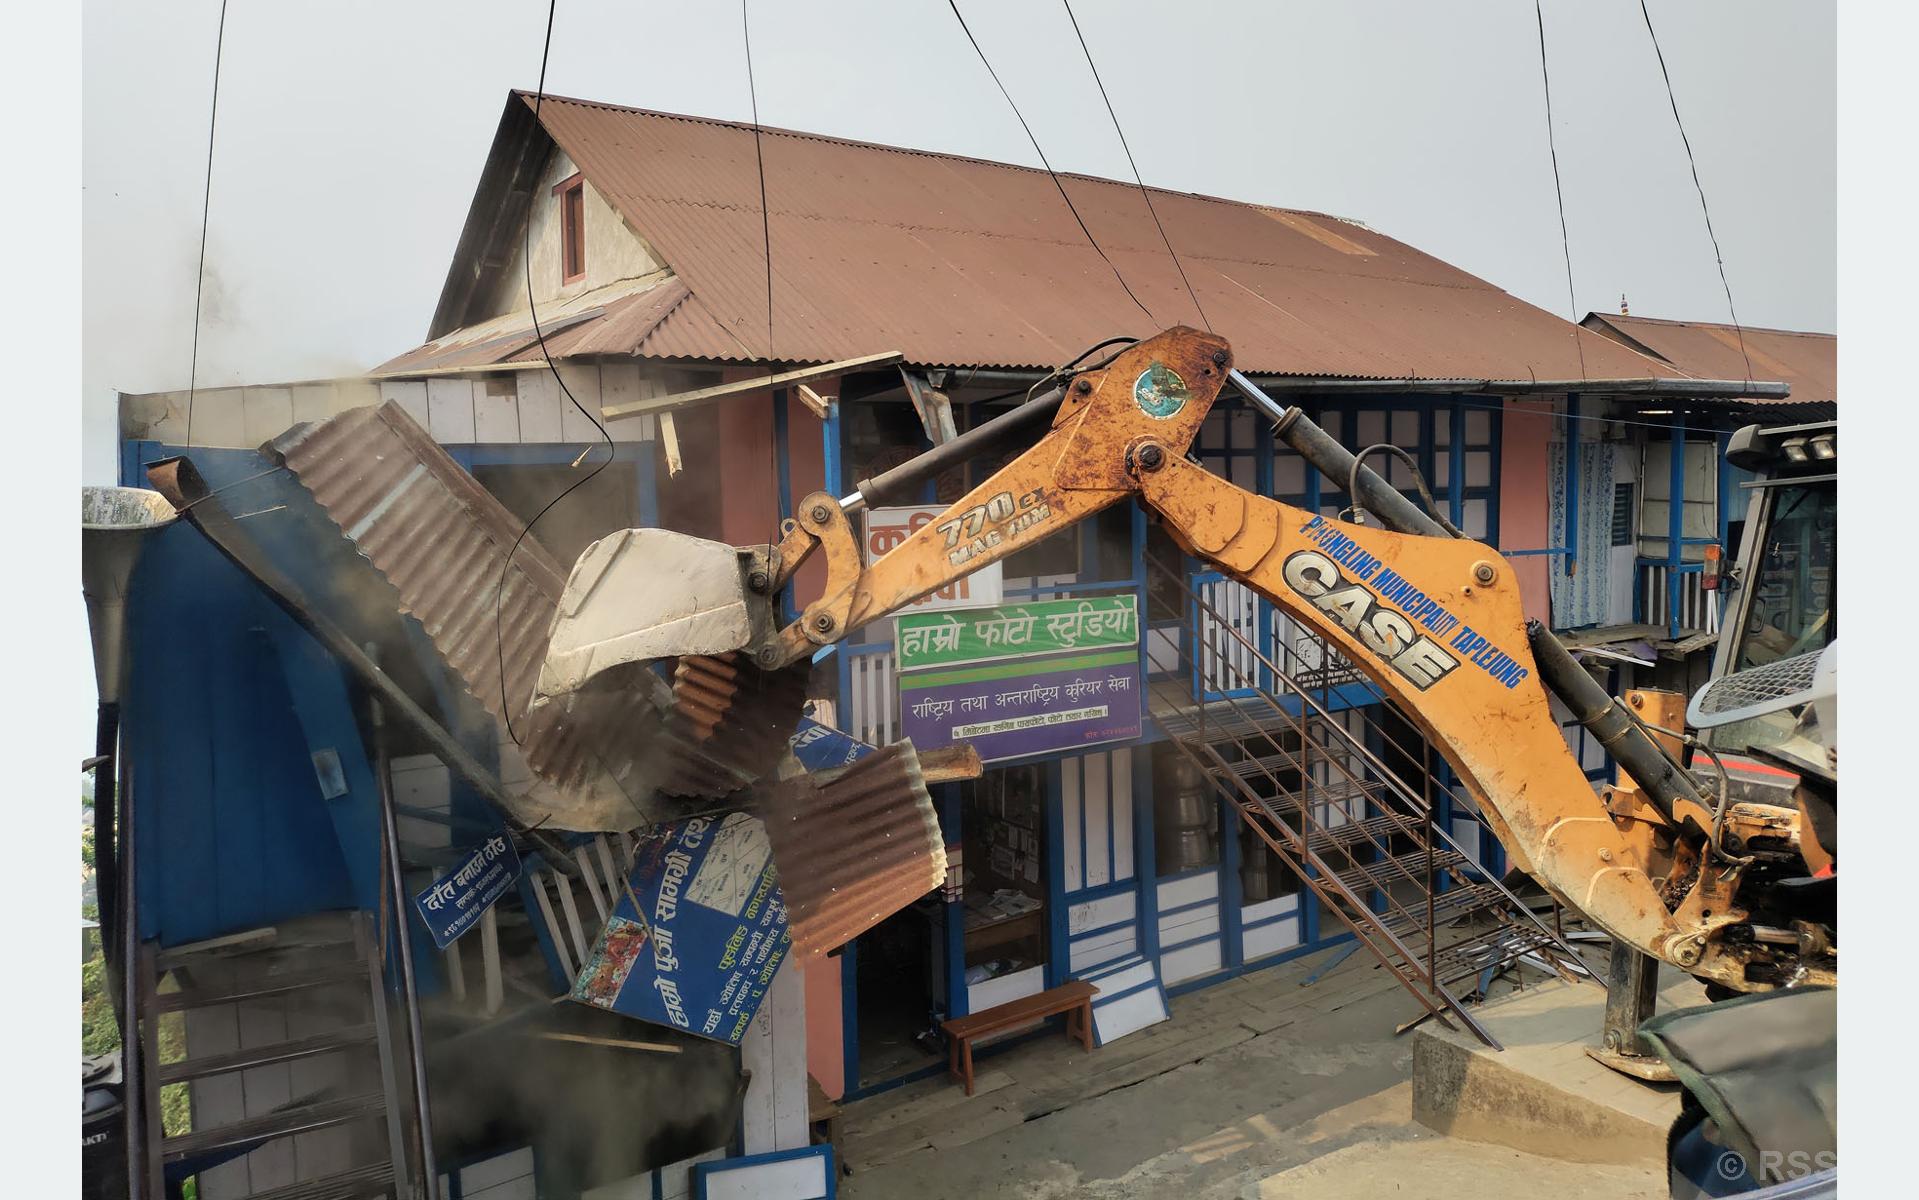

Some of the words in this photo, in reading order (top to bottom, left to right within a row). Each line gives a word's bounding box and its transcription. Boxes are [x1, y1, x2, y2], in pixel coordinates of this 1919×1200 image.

[936, 491, 1015, 549] 770
[902, 615, 966, 656] हाम्रो
[976, 609, 1039, 647] फोटो
[1047, 600, 1133, 647] स्टुडियो
[1282, 550, 1461, 692] CASE
[1449, 626, 1529, 690] TAPLEJUNG
[912, 698, 954, 721] राष्ट्रिय
[961, 696, 987, 713] तथा
[1066, 678, 1103, 702] कुरियर
[1108, 674, 1130, 691] सेवा
[423, 881, 456, 911] दाँत
[453, 850, 487, 887] बनाउने
[656, 849, 692, 922] सामग्री
[746, 859, 778, 920] नगरपालि
[654, 975, 689, 1028] हाम्रो
